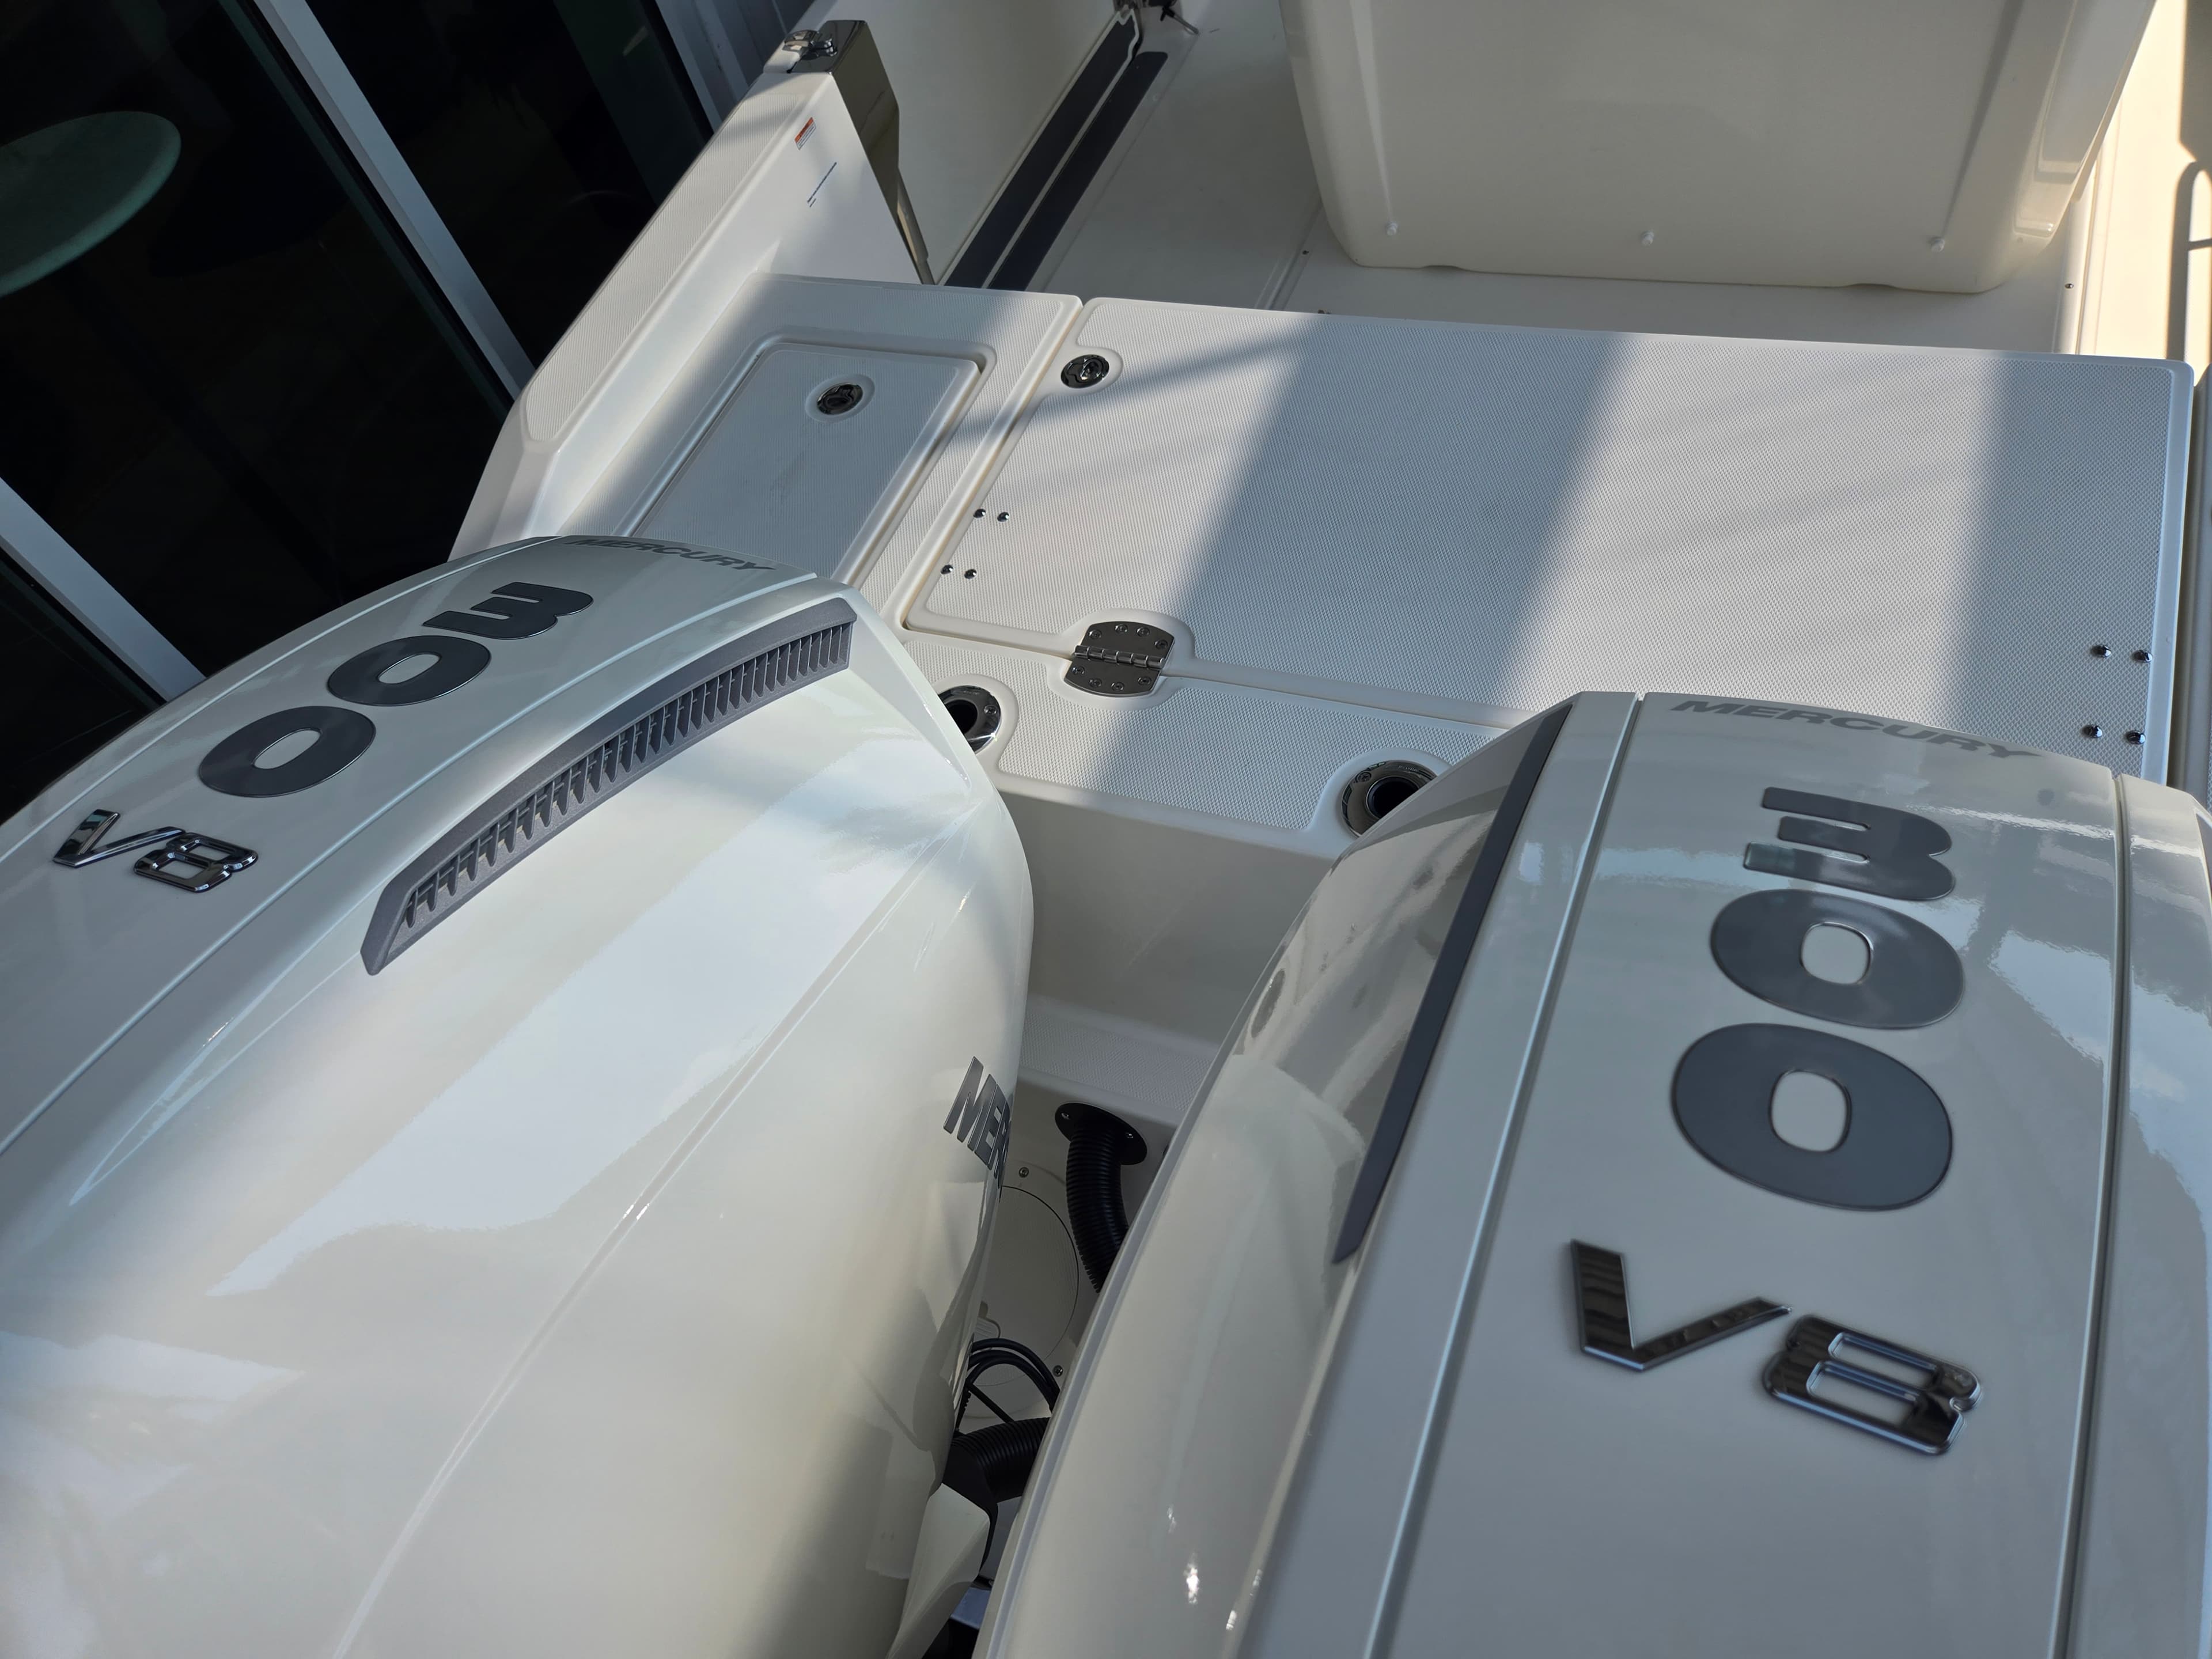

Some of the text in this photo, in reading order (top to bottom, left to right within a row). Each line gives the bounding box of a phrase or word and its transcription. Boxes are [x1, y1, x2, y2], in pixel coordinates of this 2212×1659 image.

[563, 539, 776, 570] MERCURY
[198, 582, 593, 798] 300
[1670, 700, 2044, 759] MERCURY
[52, 809, 259, 893] V8
[1671, 786, 1964, 1212] 300
[1570, 1240, 1982, 1455] V8
